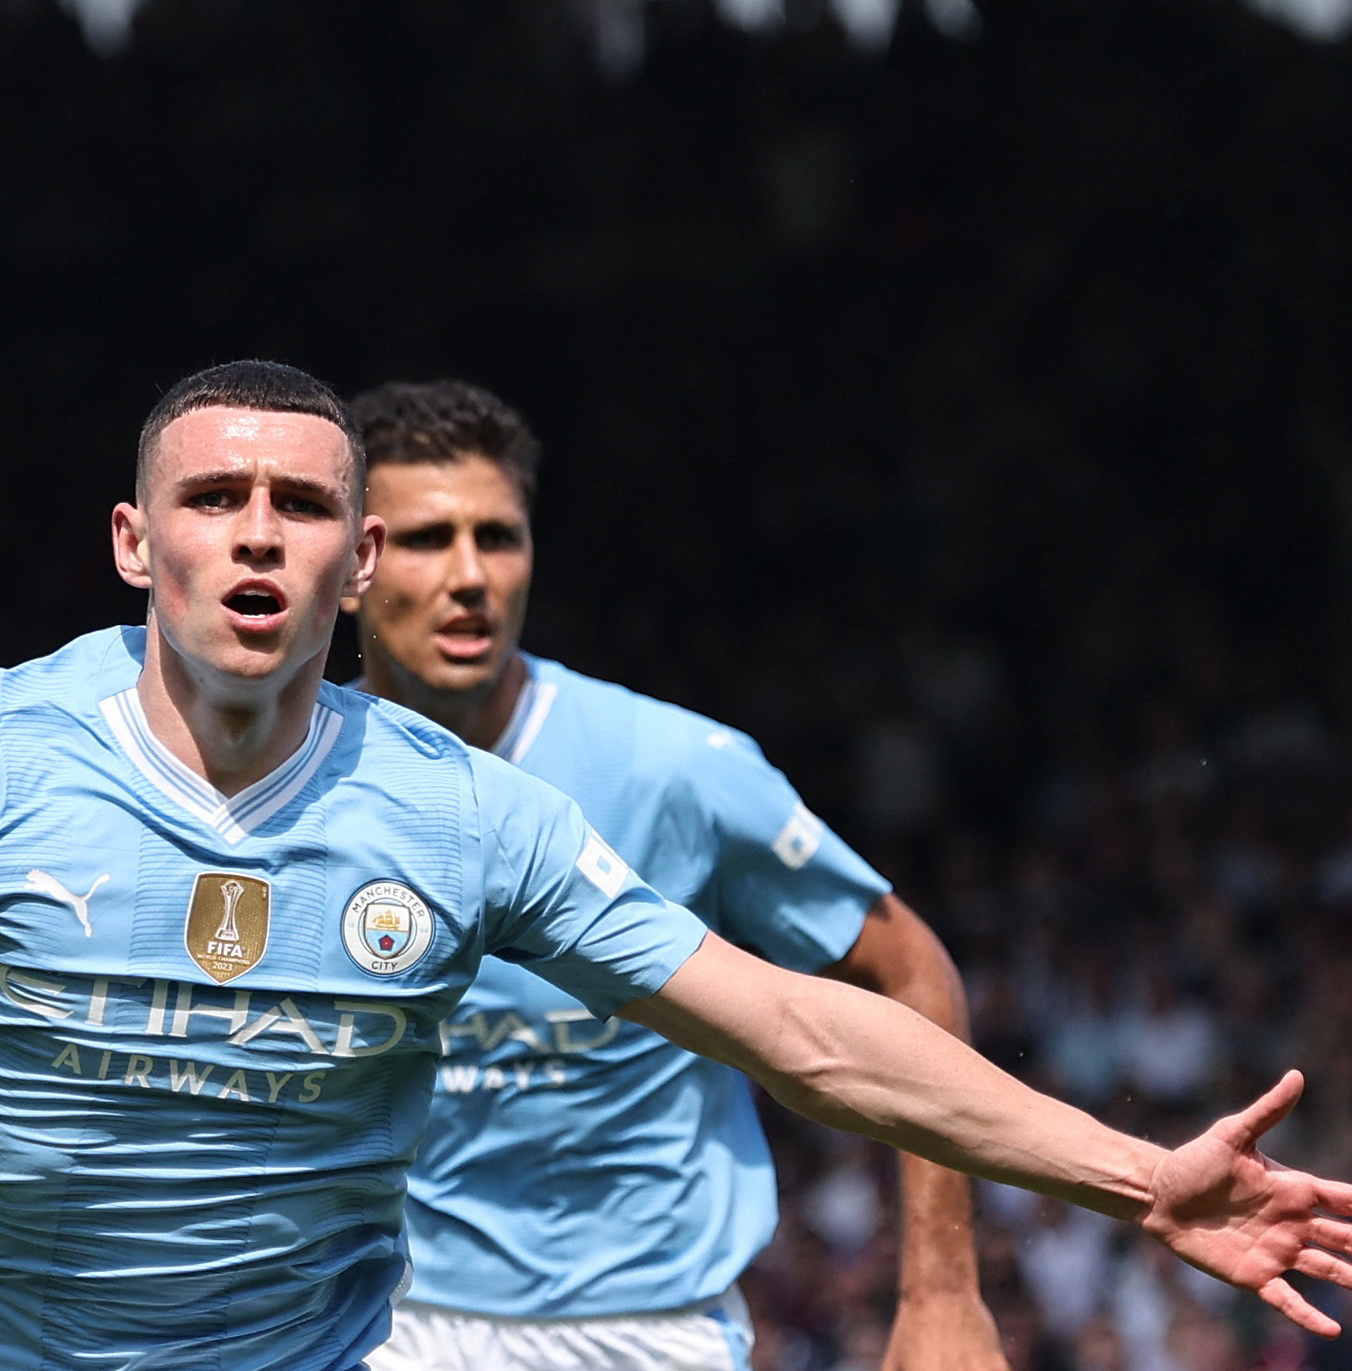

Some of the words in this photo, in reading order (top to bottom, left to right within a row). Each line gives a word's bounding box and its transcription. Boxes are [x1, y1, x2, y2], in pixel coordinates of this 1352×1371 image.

[351, 886, 425, 918] MANCHESTER
[207, 941, 243, 958] FIFA
[212, 961, 233, 971] 2023
[371, 961, 398, 971] CITY
[439, 1009, 621, 1057] HAD
[51, 1043, 326, 1103] AIRWAYS
[439, 1058, 566, 1093] WAYS
